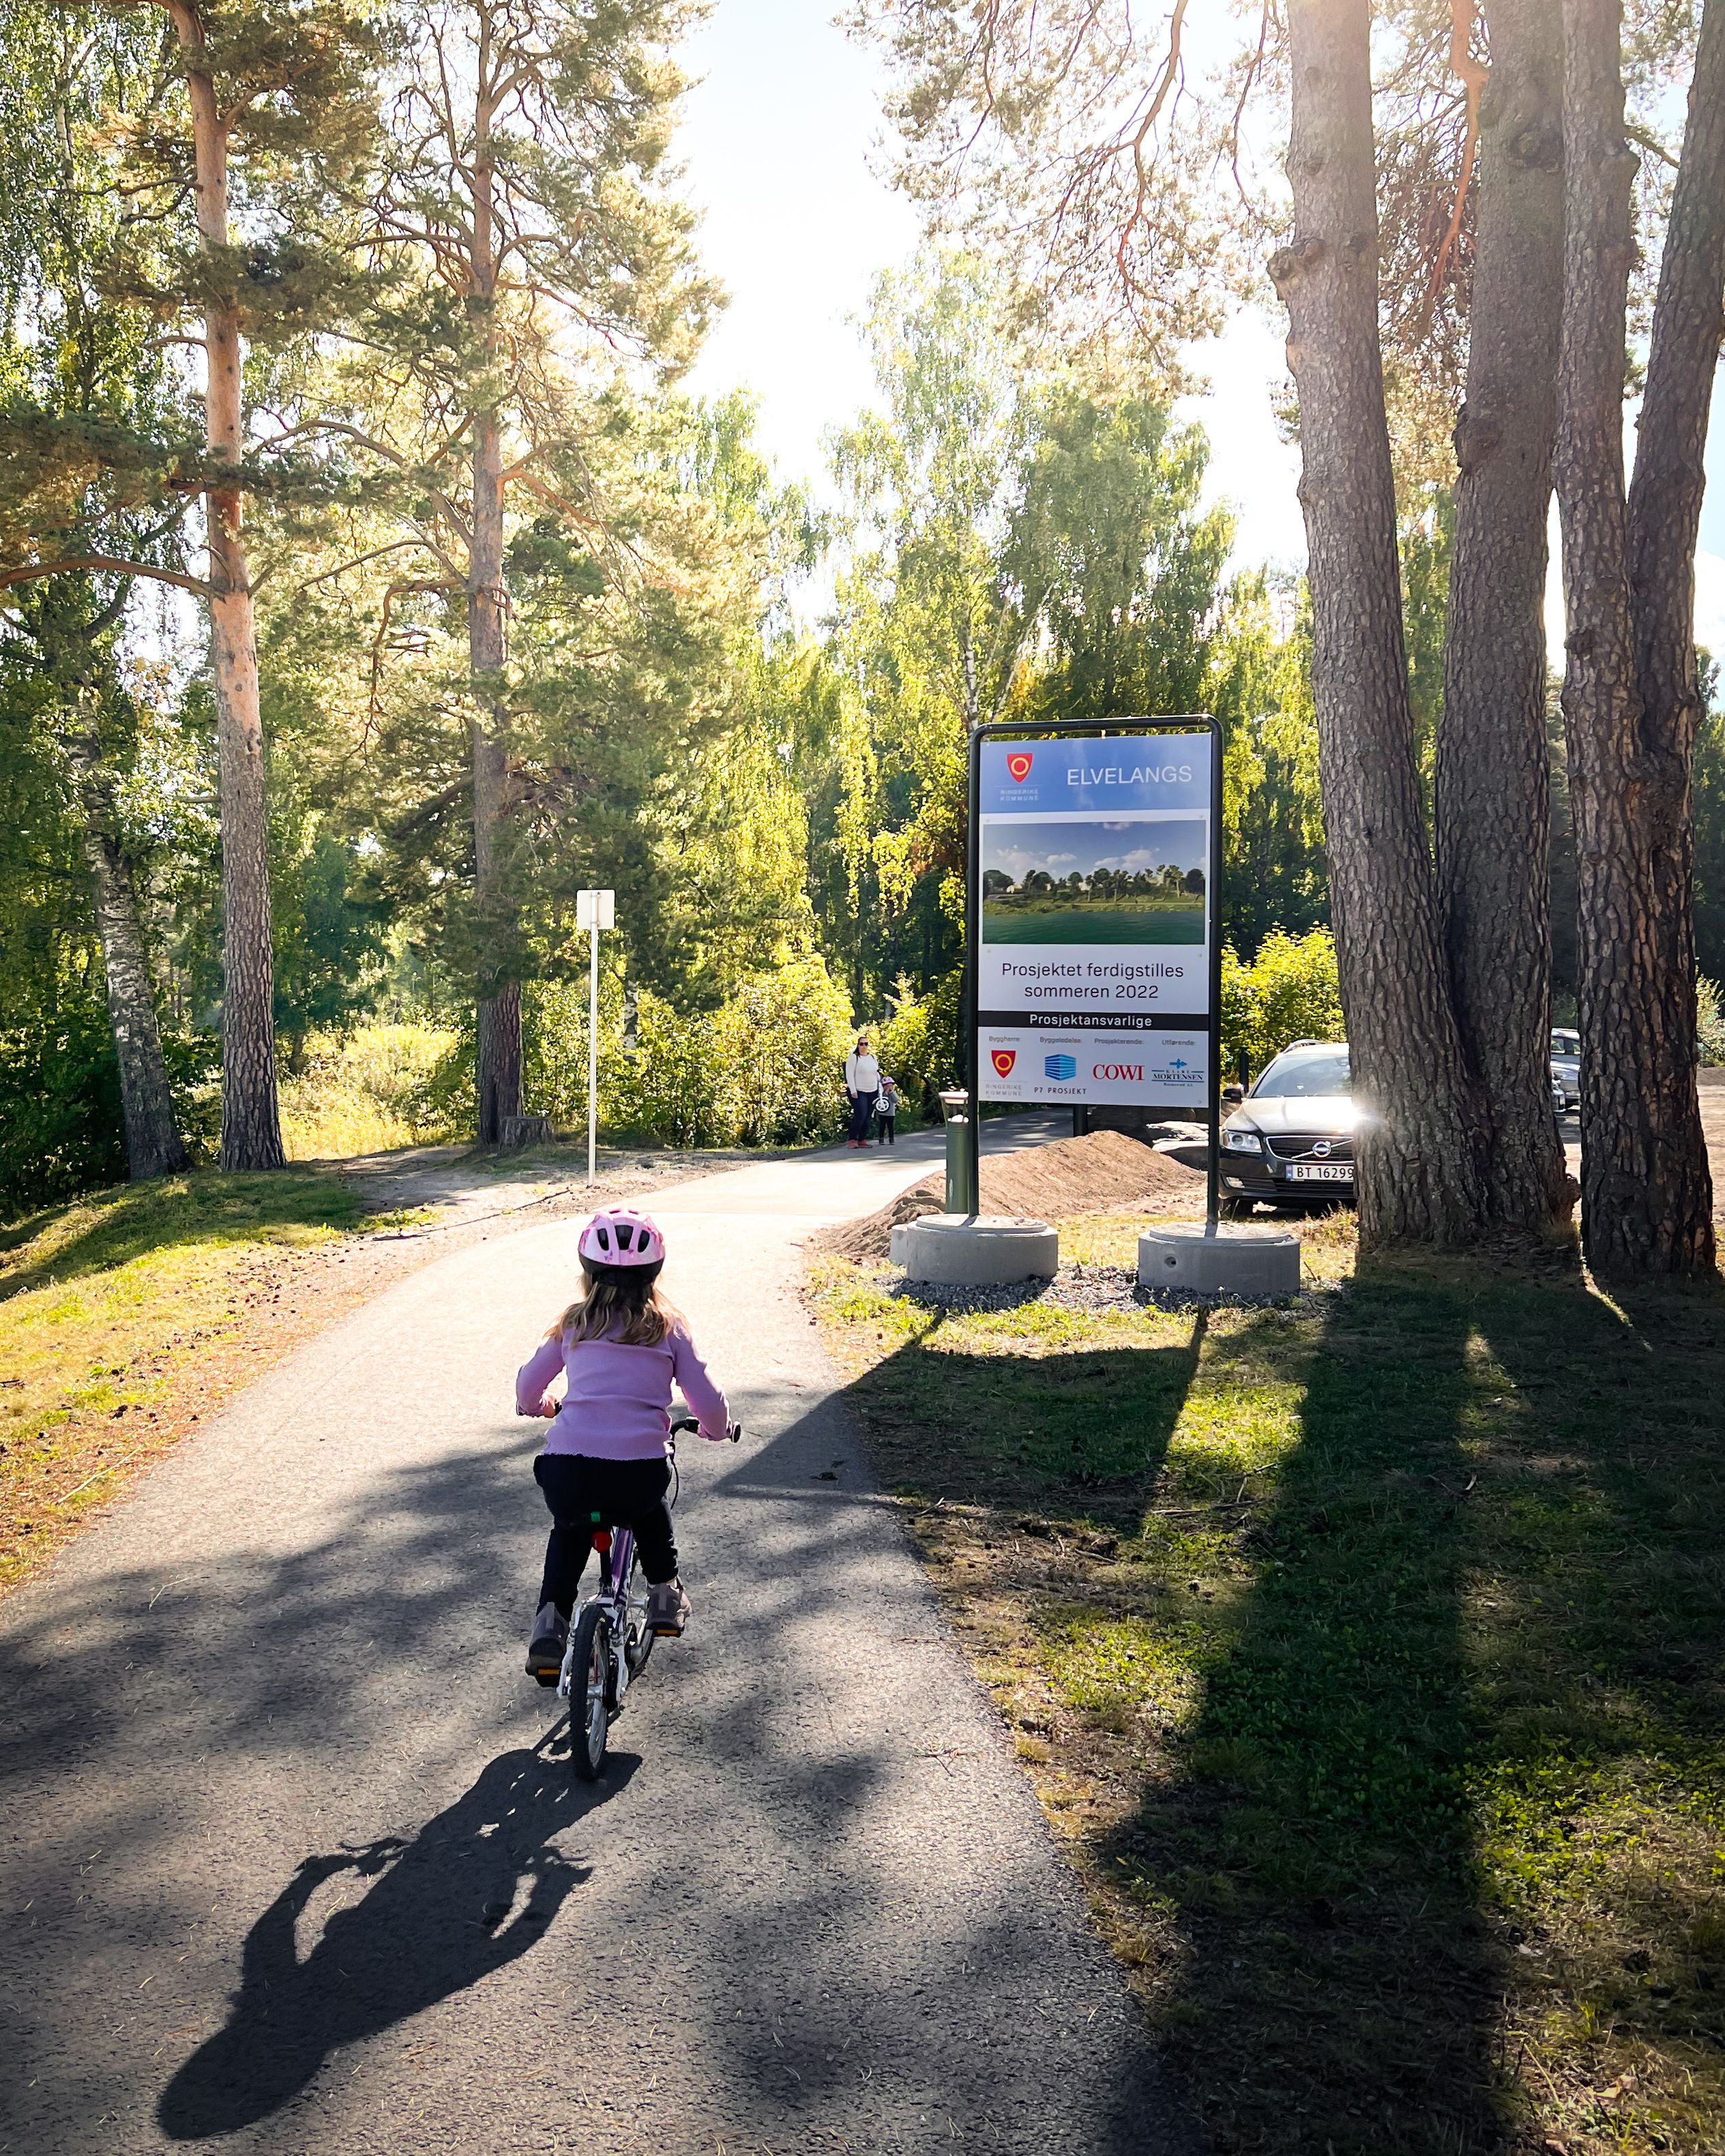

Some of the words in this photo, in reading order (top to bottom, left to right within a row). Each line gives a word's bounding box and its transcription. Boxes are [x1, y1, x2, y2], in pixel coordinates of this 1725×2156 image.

[1067, 766, 1192, 786] ELVELANGS
[1002, 962, 1082, 979] Prosjektet
[1087, 962, 1184, 980] ferdigstilles
[1024, 986, 1110, 998] sommeren
[1115, 985, 1159, 999] 2022
[1029, 1014, 1152, 1028] Prosjektansvarlige
[1093, 1064, 1145, 1081] COWI
[1297, 1167, 1312, 1178] BT
[1317, 1168, 1354, 1179] 16299
